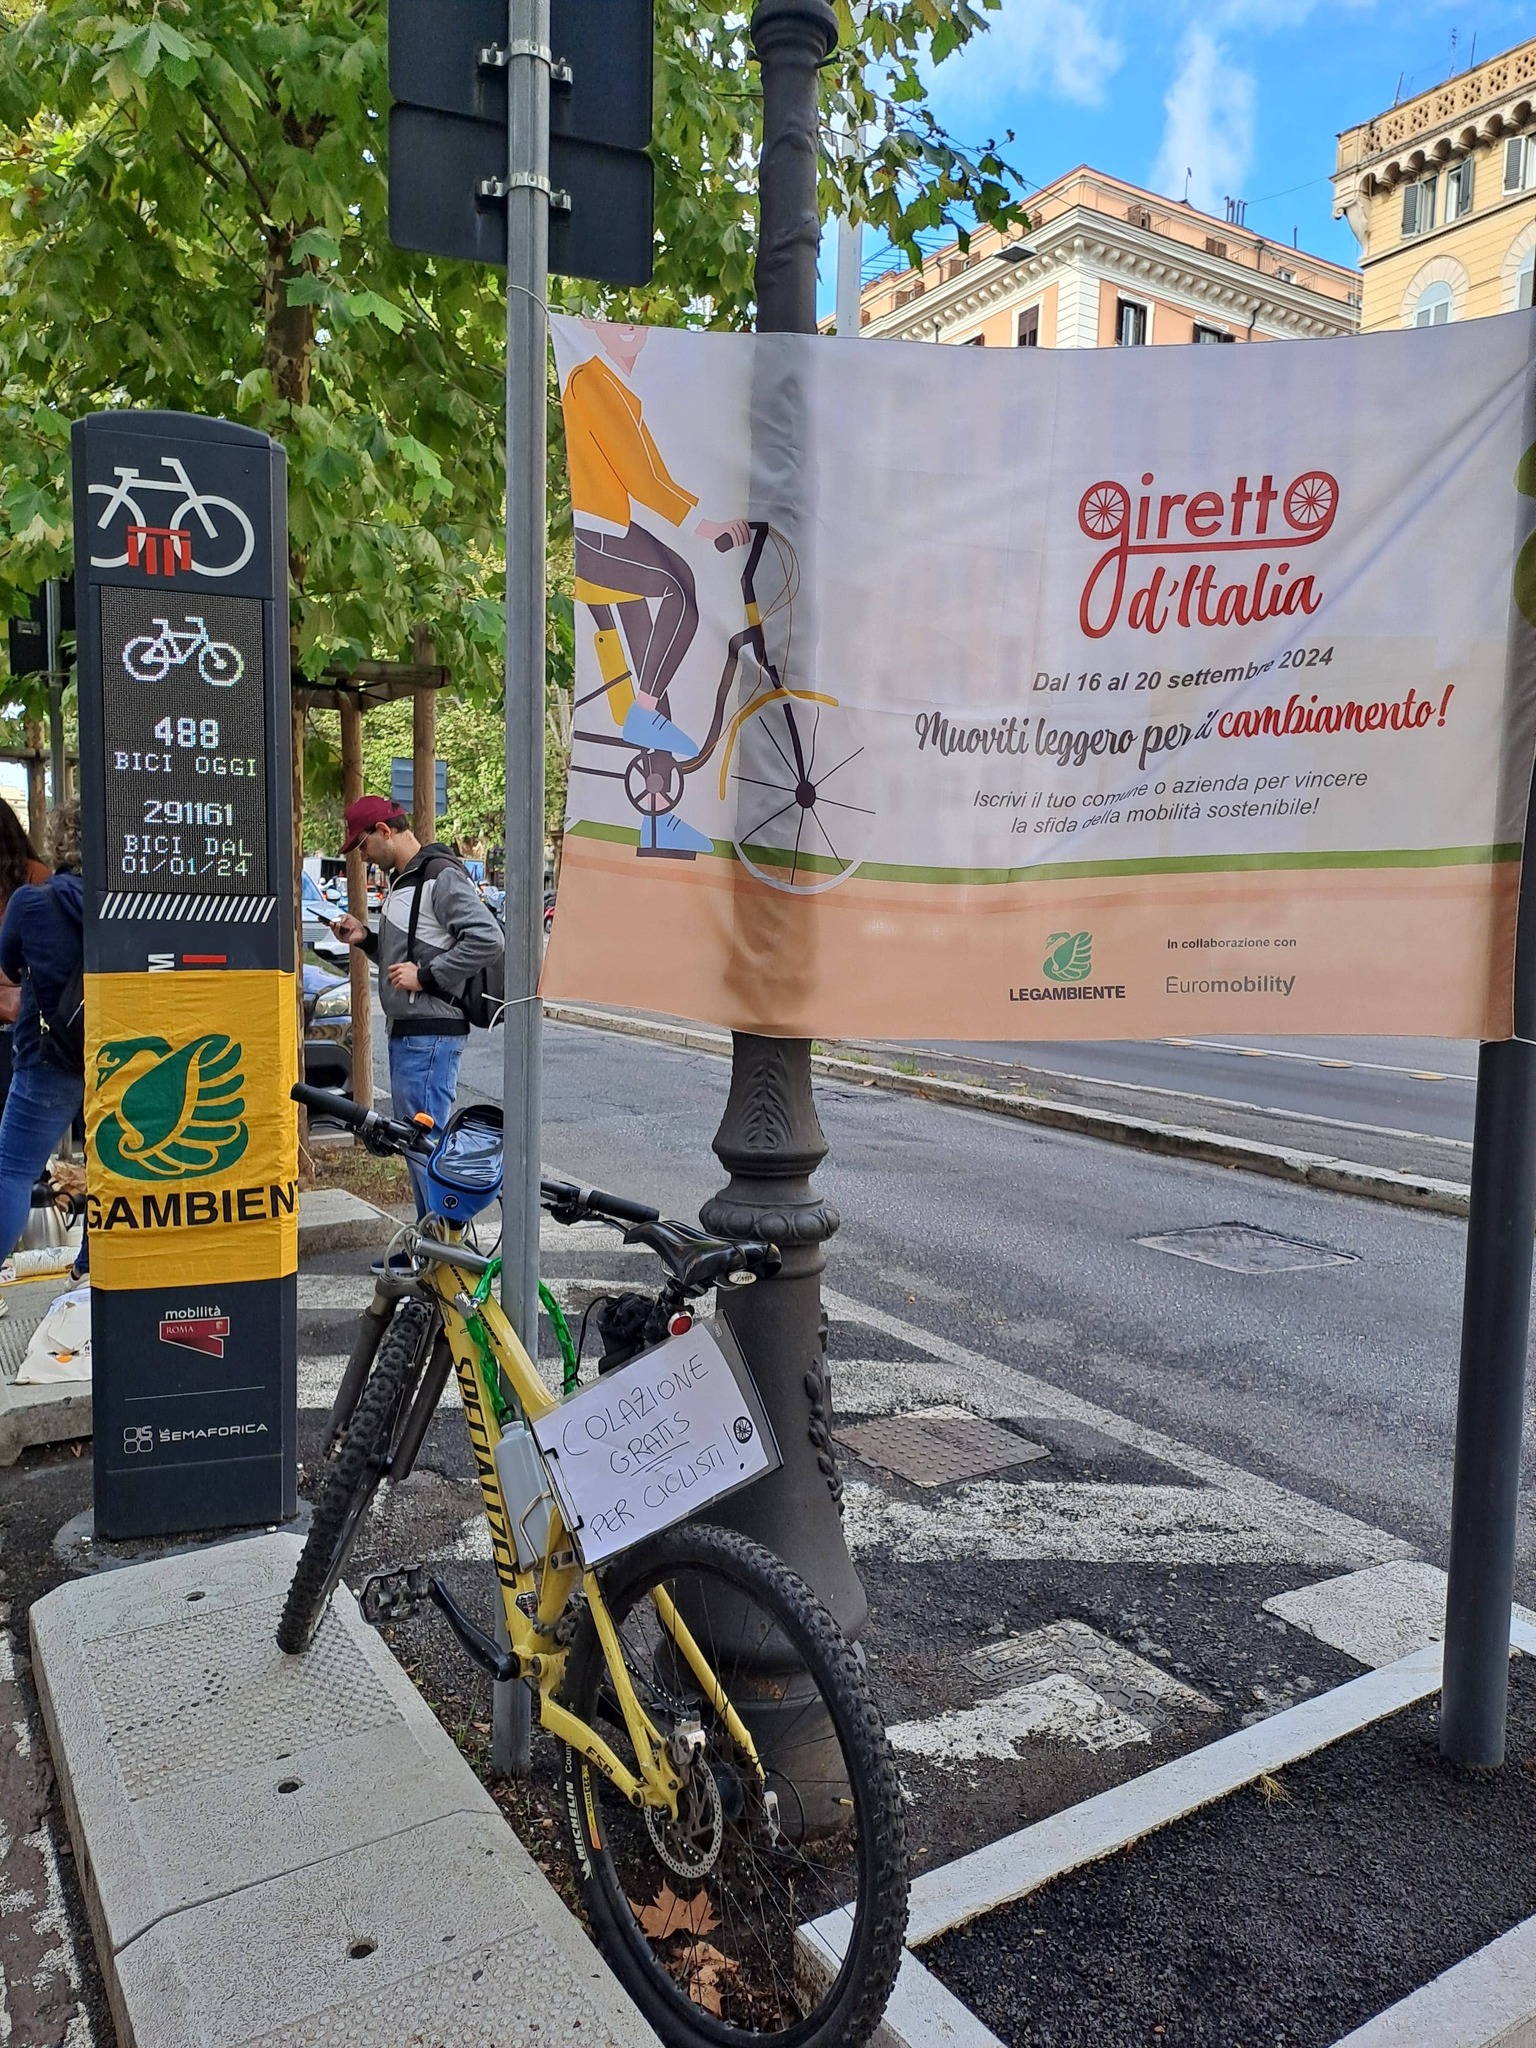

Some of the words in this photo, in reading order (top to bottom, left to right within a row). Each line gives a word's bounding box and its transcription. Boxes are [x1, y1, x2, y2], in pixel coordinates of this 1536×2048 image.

[1128, 562, 1324, 634] d'Italia
[1032, 672, 1068, 692] Dal
[1076, 672, 1101, 692] 16
[1107, 672, 1129, 691] al
[1135, 671, 1161, 690] 20
[1167, 658, 1275, 689] settembre
[1278, 646, 1335, 670] 2024
[154, 716, 219, 749] 488
[914, 711, 1029, 758] Muoviti
[1034, 715, 1138, 767] leggero
[1138, 722, 1191, 771] per
[1195, 709, 1219, 740] il
[1219, 684, 1455, 739] cambiamento!
[114, 751, 172, 772] BICI
[195, 756, 256, 776] OGGI
[973, 790, 1026, 810] Iscrivi
[1031, 790, 1042, 809] il
[1046, 790, 1077, 808] tuo
[1082, 782, 1148, 808] comune
[1154, 780, 1166, 795] o
[1172, 774, 1249, 795] azienda
[1253, 775, 1291, 794] per
[1295, 770, 1369, 789] vincere
[143, 800, 233, 826] 291161
[1010, 818, 1027, 834] la
[1033, 817, 1078, 834] sfida
[1082, 809, 1121, 830] della
[1126, 801, 1201, 823] mobilità
[1206, 797, 1320, 820] sostenibile!
[124, 834, 181, 853] BICI
[204, 838, 253, 856] DAL
[122, 856, 249, 876] 01/01/24
[1166, 938, 1178, 949] In
[1181, 937, 1271, 950] collaborazione
[1274, 938, 1298, 949] con
[1009, 985, 1126, 1002] LEGAMBIENTE
[1165, 975, 1297, 997] Euromobility
[86, 1180, 299, 1230] GAMBIEN
[165, 1305, 222, 1320] mobilità
[166, 1325, 194, 1335] ROMA
[562, 1353, 709, 1457] COLAZIONE
[160, 1423, 268, 1442] SEMAFORICA
[609, 1411, 691, 1475] GRATIS
[454, 1356, 518, 1590] SPECIALIZED
[589, 1498, 636, 1542] PER
[565, 1780, 587, 1861] MICHELIN
